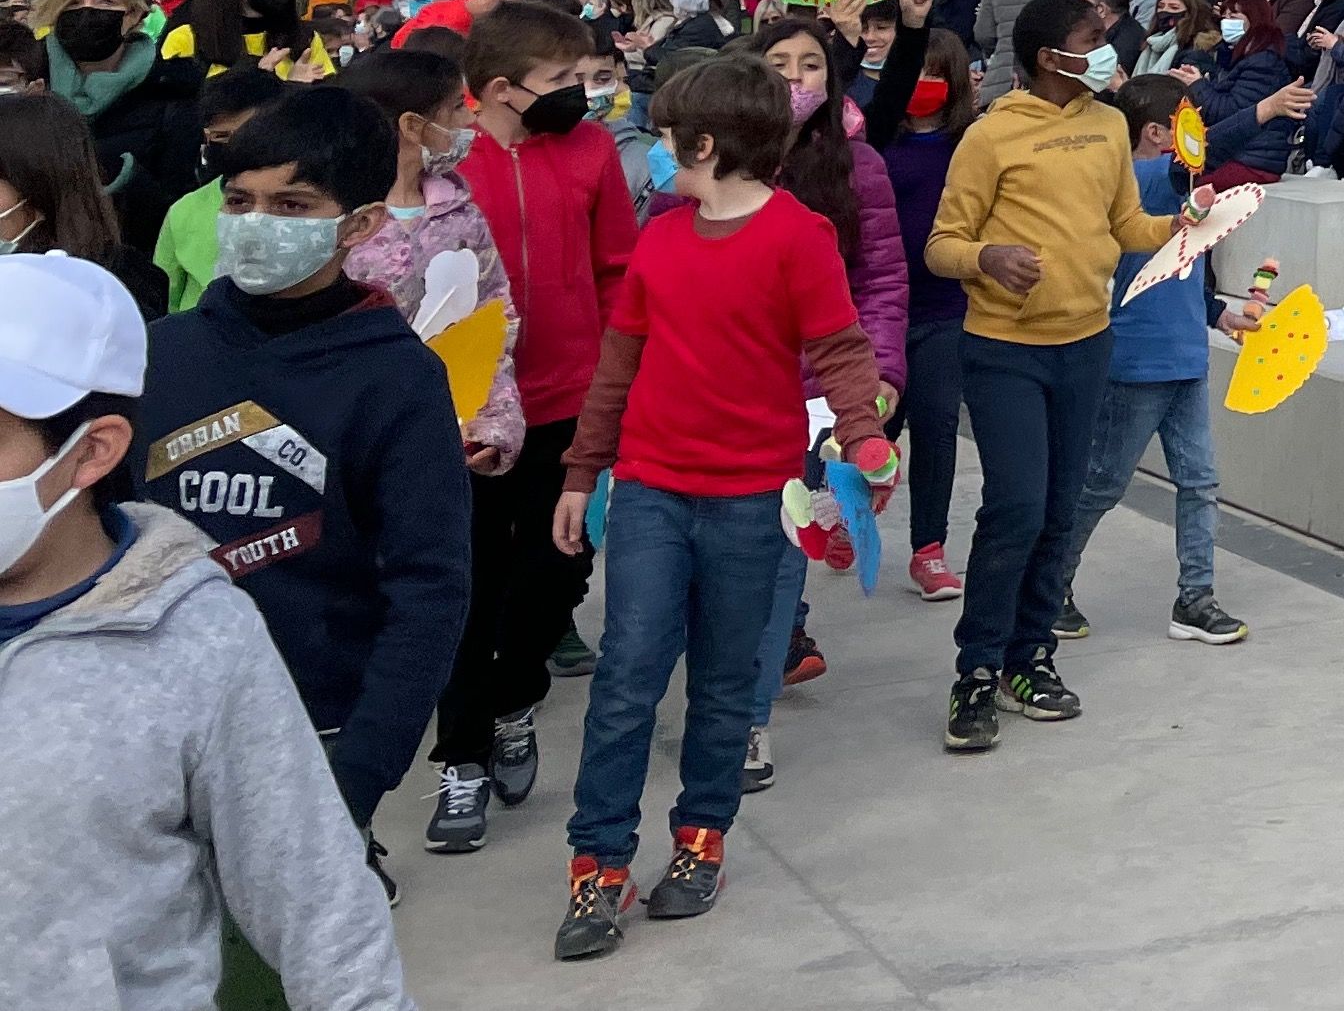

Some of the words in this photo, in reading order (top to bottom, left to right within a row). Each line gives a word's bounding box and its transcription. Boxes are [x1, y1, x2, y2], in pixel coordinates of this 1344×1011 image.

[166, 412, 241, 460] URBAN
[278, 439, 307, 471] CO.
[179, 470, 284, 518] COOL
[223, 526, 300, 571] YOUTH
